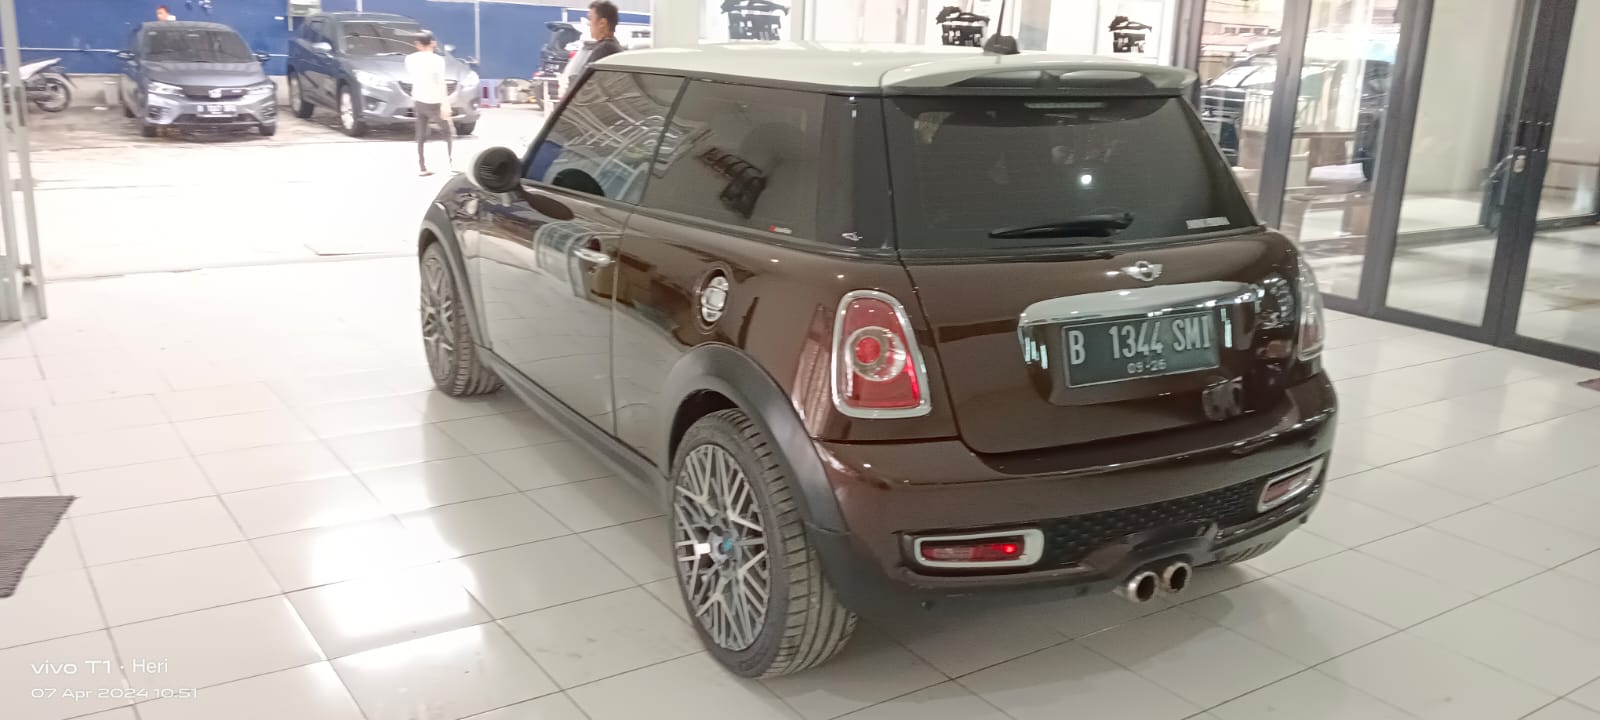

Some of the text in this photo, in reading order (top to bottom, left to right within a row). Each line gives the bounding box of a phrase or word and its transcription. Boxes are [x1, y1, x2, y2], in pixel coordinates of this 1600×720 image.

[1068, 315, 1211, 365] B 1344 SMI
